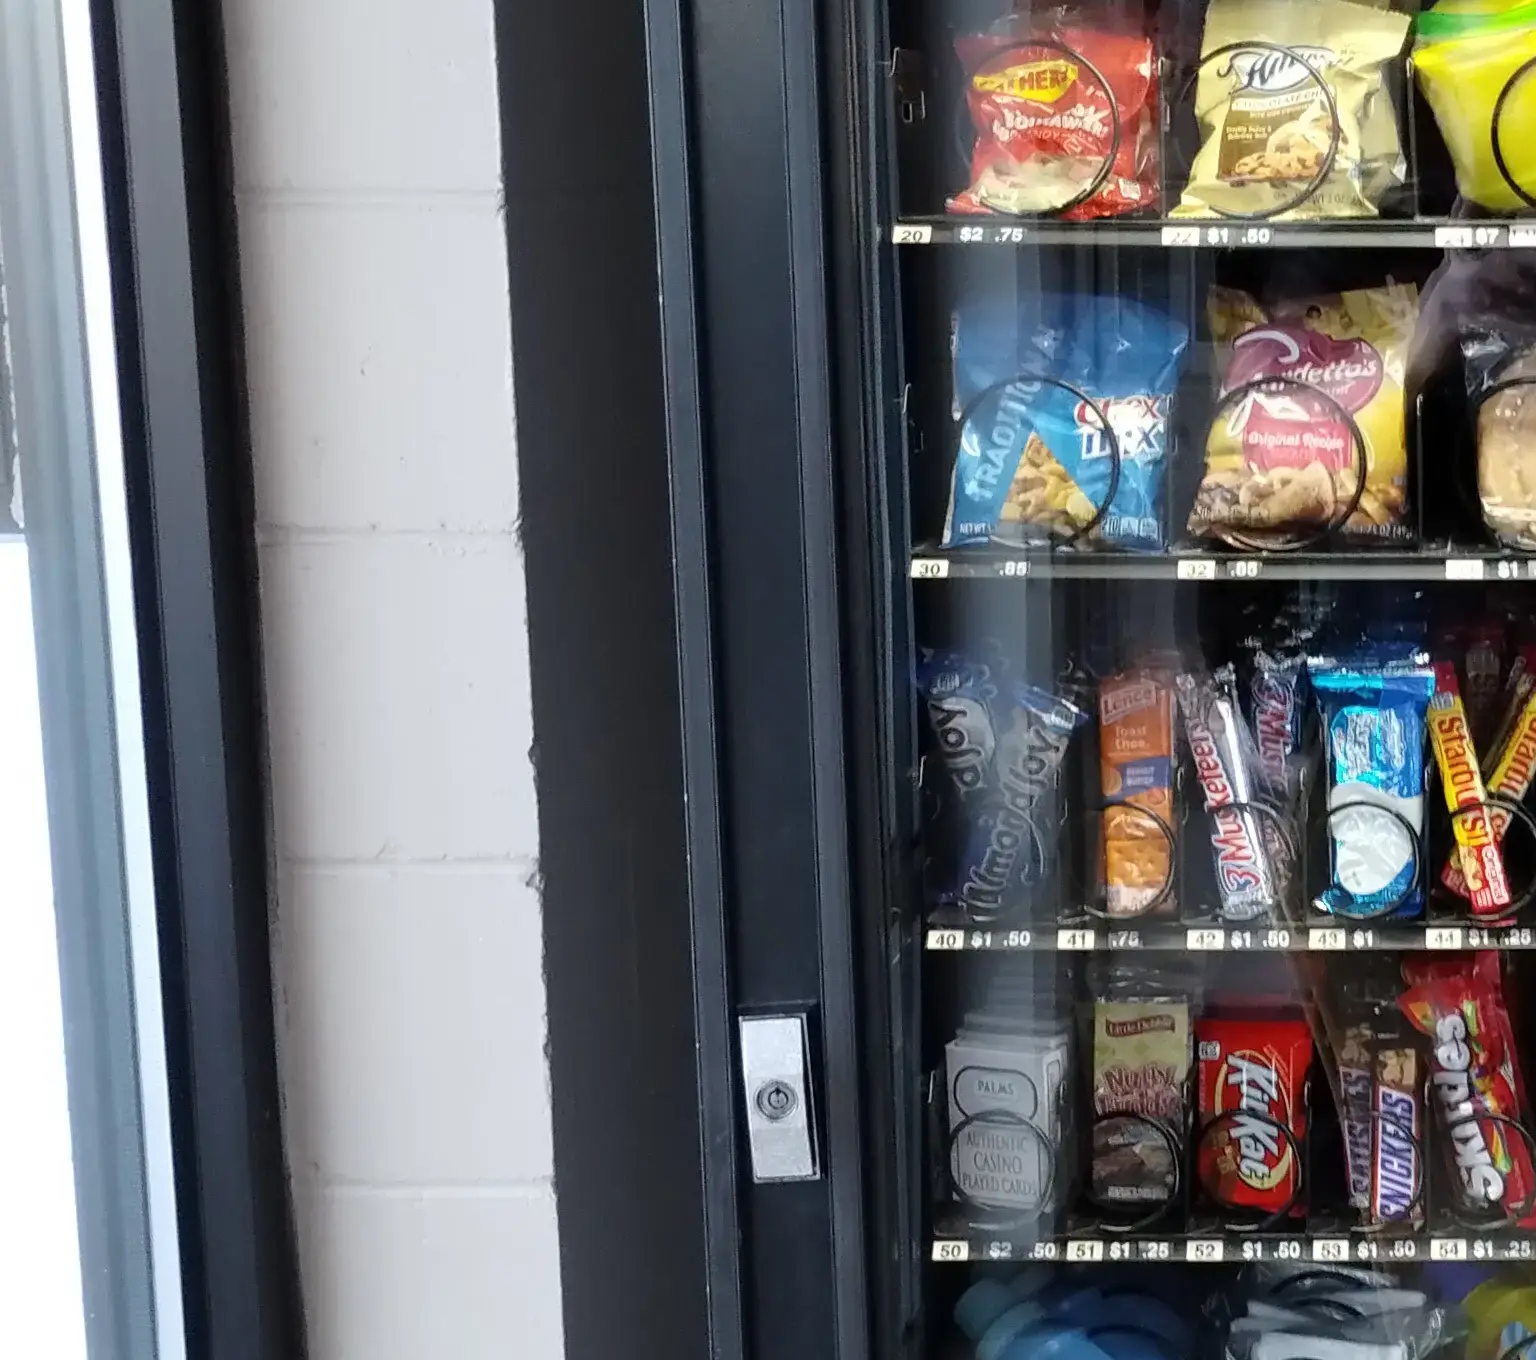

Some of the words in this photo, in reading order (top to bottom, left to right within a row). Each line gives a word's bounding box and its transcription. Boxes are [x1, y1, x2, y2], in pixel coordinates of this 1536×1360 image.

[902, 229, 922, 242] 20
[1248, 431, 1299, 449] Original
[1302, 432, 1344, 451] Recipe
[1222, 866, 1261, 893] 3
[977, 1079, 1015, 1096] PALMS
[1227, 1054, 1279, 1118] Kit
[966, 1130, 1029, 1154] AUTHENTIC
[1228, 1114, 1280, 1184] Kat
[973, 1151, 1023, 1175] CASINO
[939, 1245, 962, 1258] 50
[1075, 1245, 1096, 1258] 51
[1194, 1245, 1216, 1258] 52
